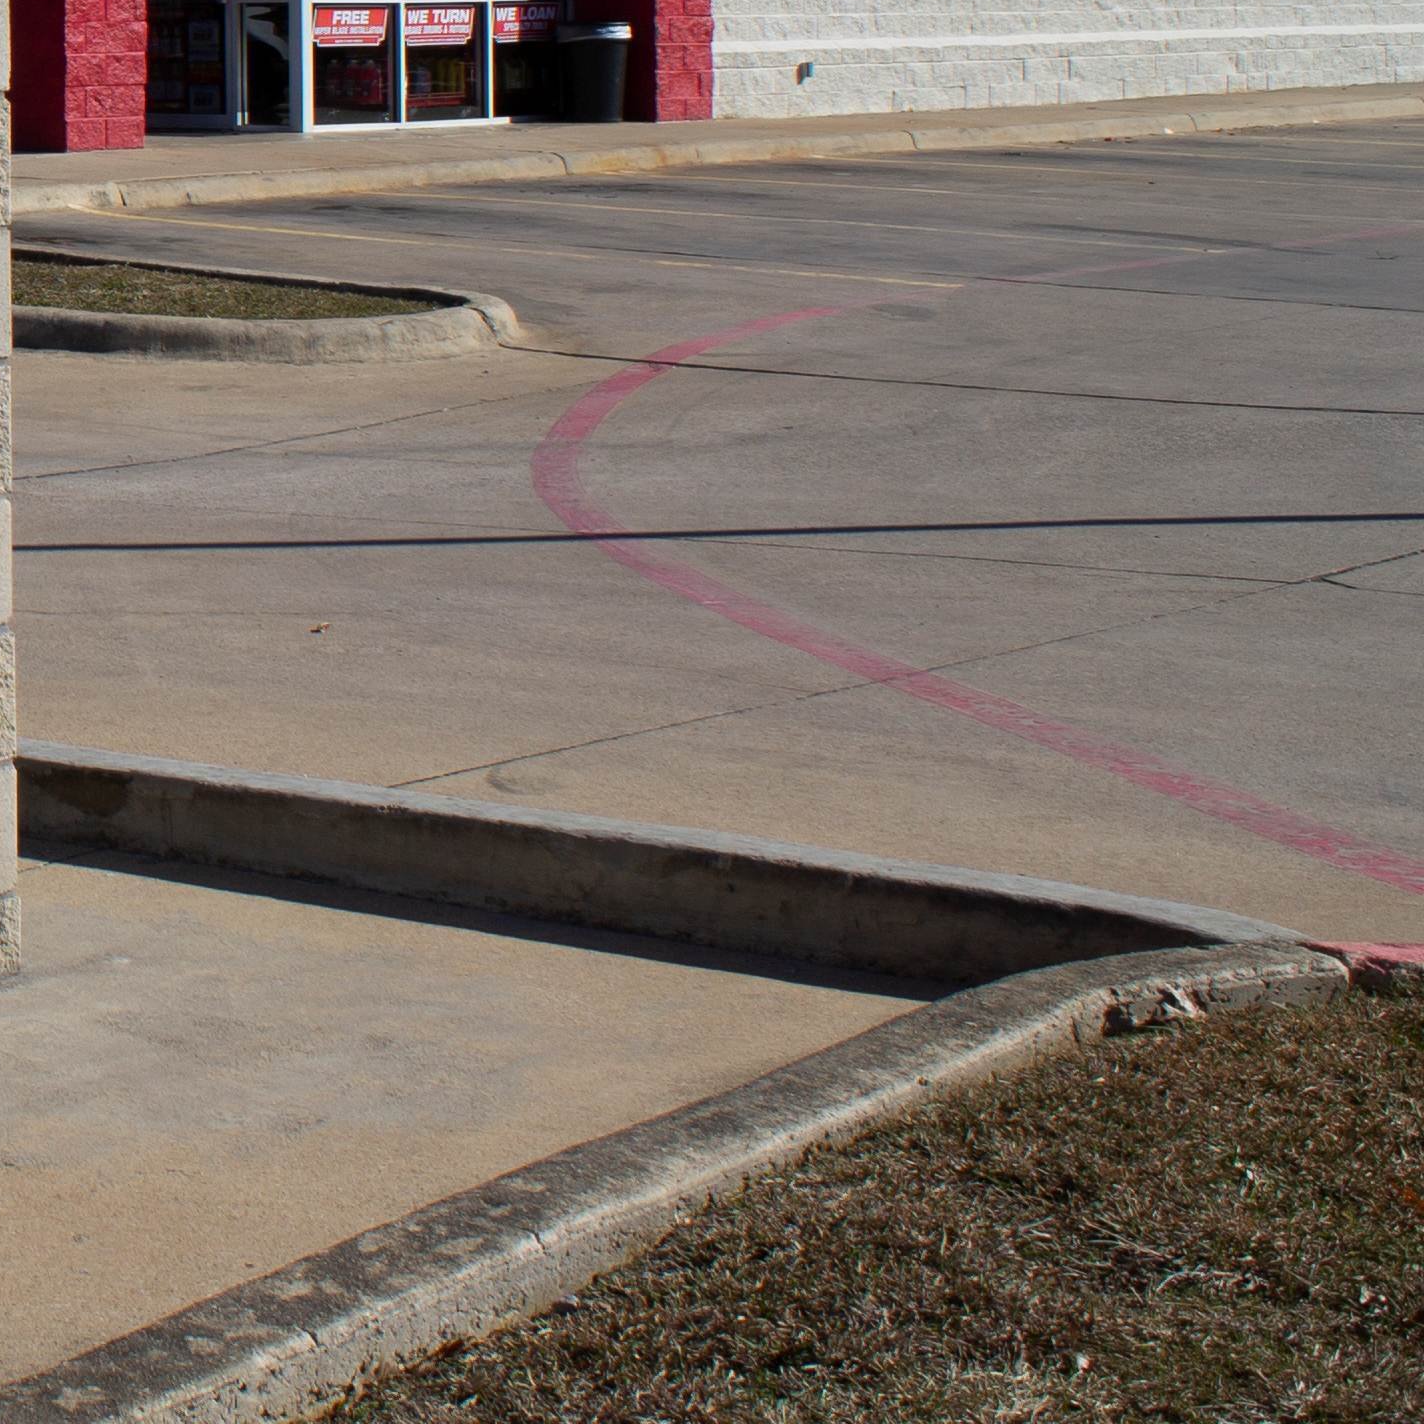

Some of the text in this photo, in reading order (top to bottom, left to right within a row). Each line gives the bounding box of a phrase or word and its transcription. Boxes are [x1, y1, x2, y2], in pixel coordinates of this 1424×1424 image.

[332, 10, 370, 25] FREE
[408, 9, 470, 25] WE TURN
[496, 6, 556, 21] WE LOAN
